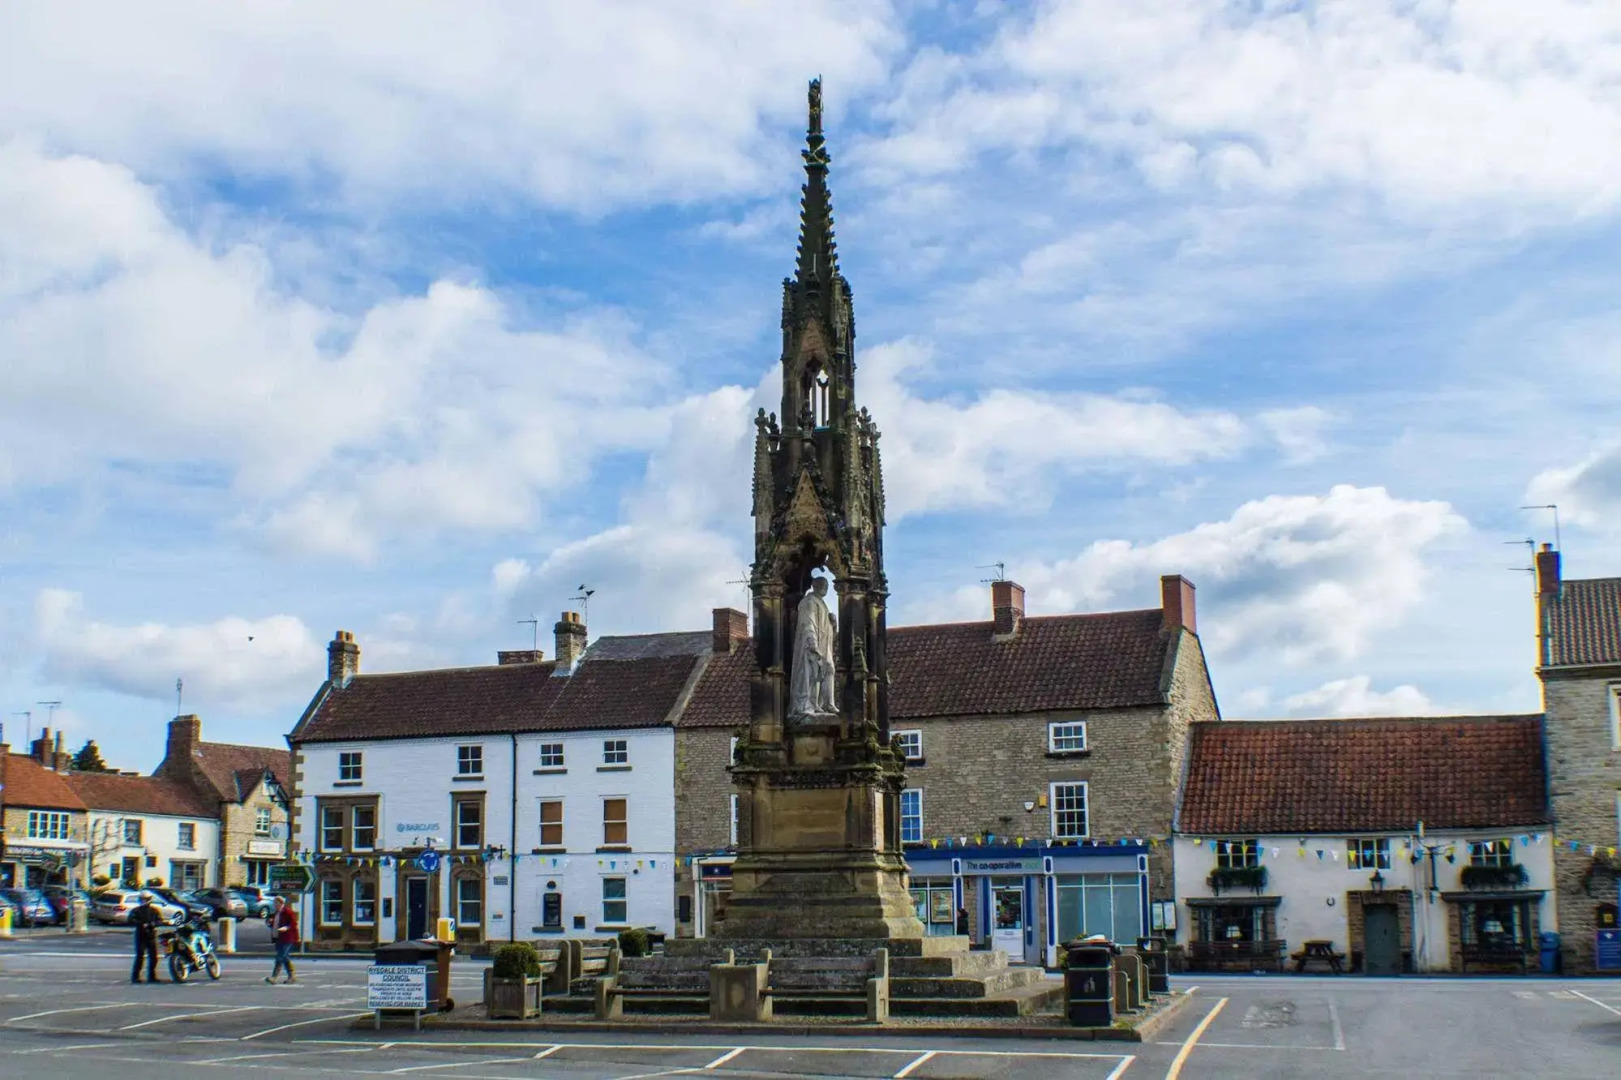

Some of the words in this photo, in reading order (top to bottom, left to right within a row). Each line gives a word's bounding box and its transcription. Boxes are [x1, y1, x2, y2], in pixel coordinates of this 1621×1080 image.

[405, 823, 440, 831] BARCLAYS
[966, 861, 978, 869] The
[979, 861, 1022, 870] co-operative
